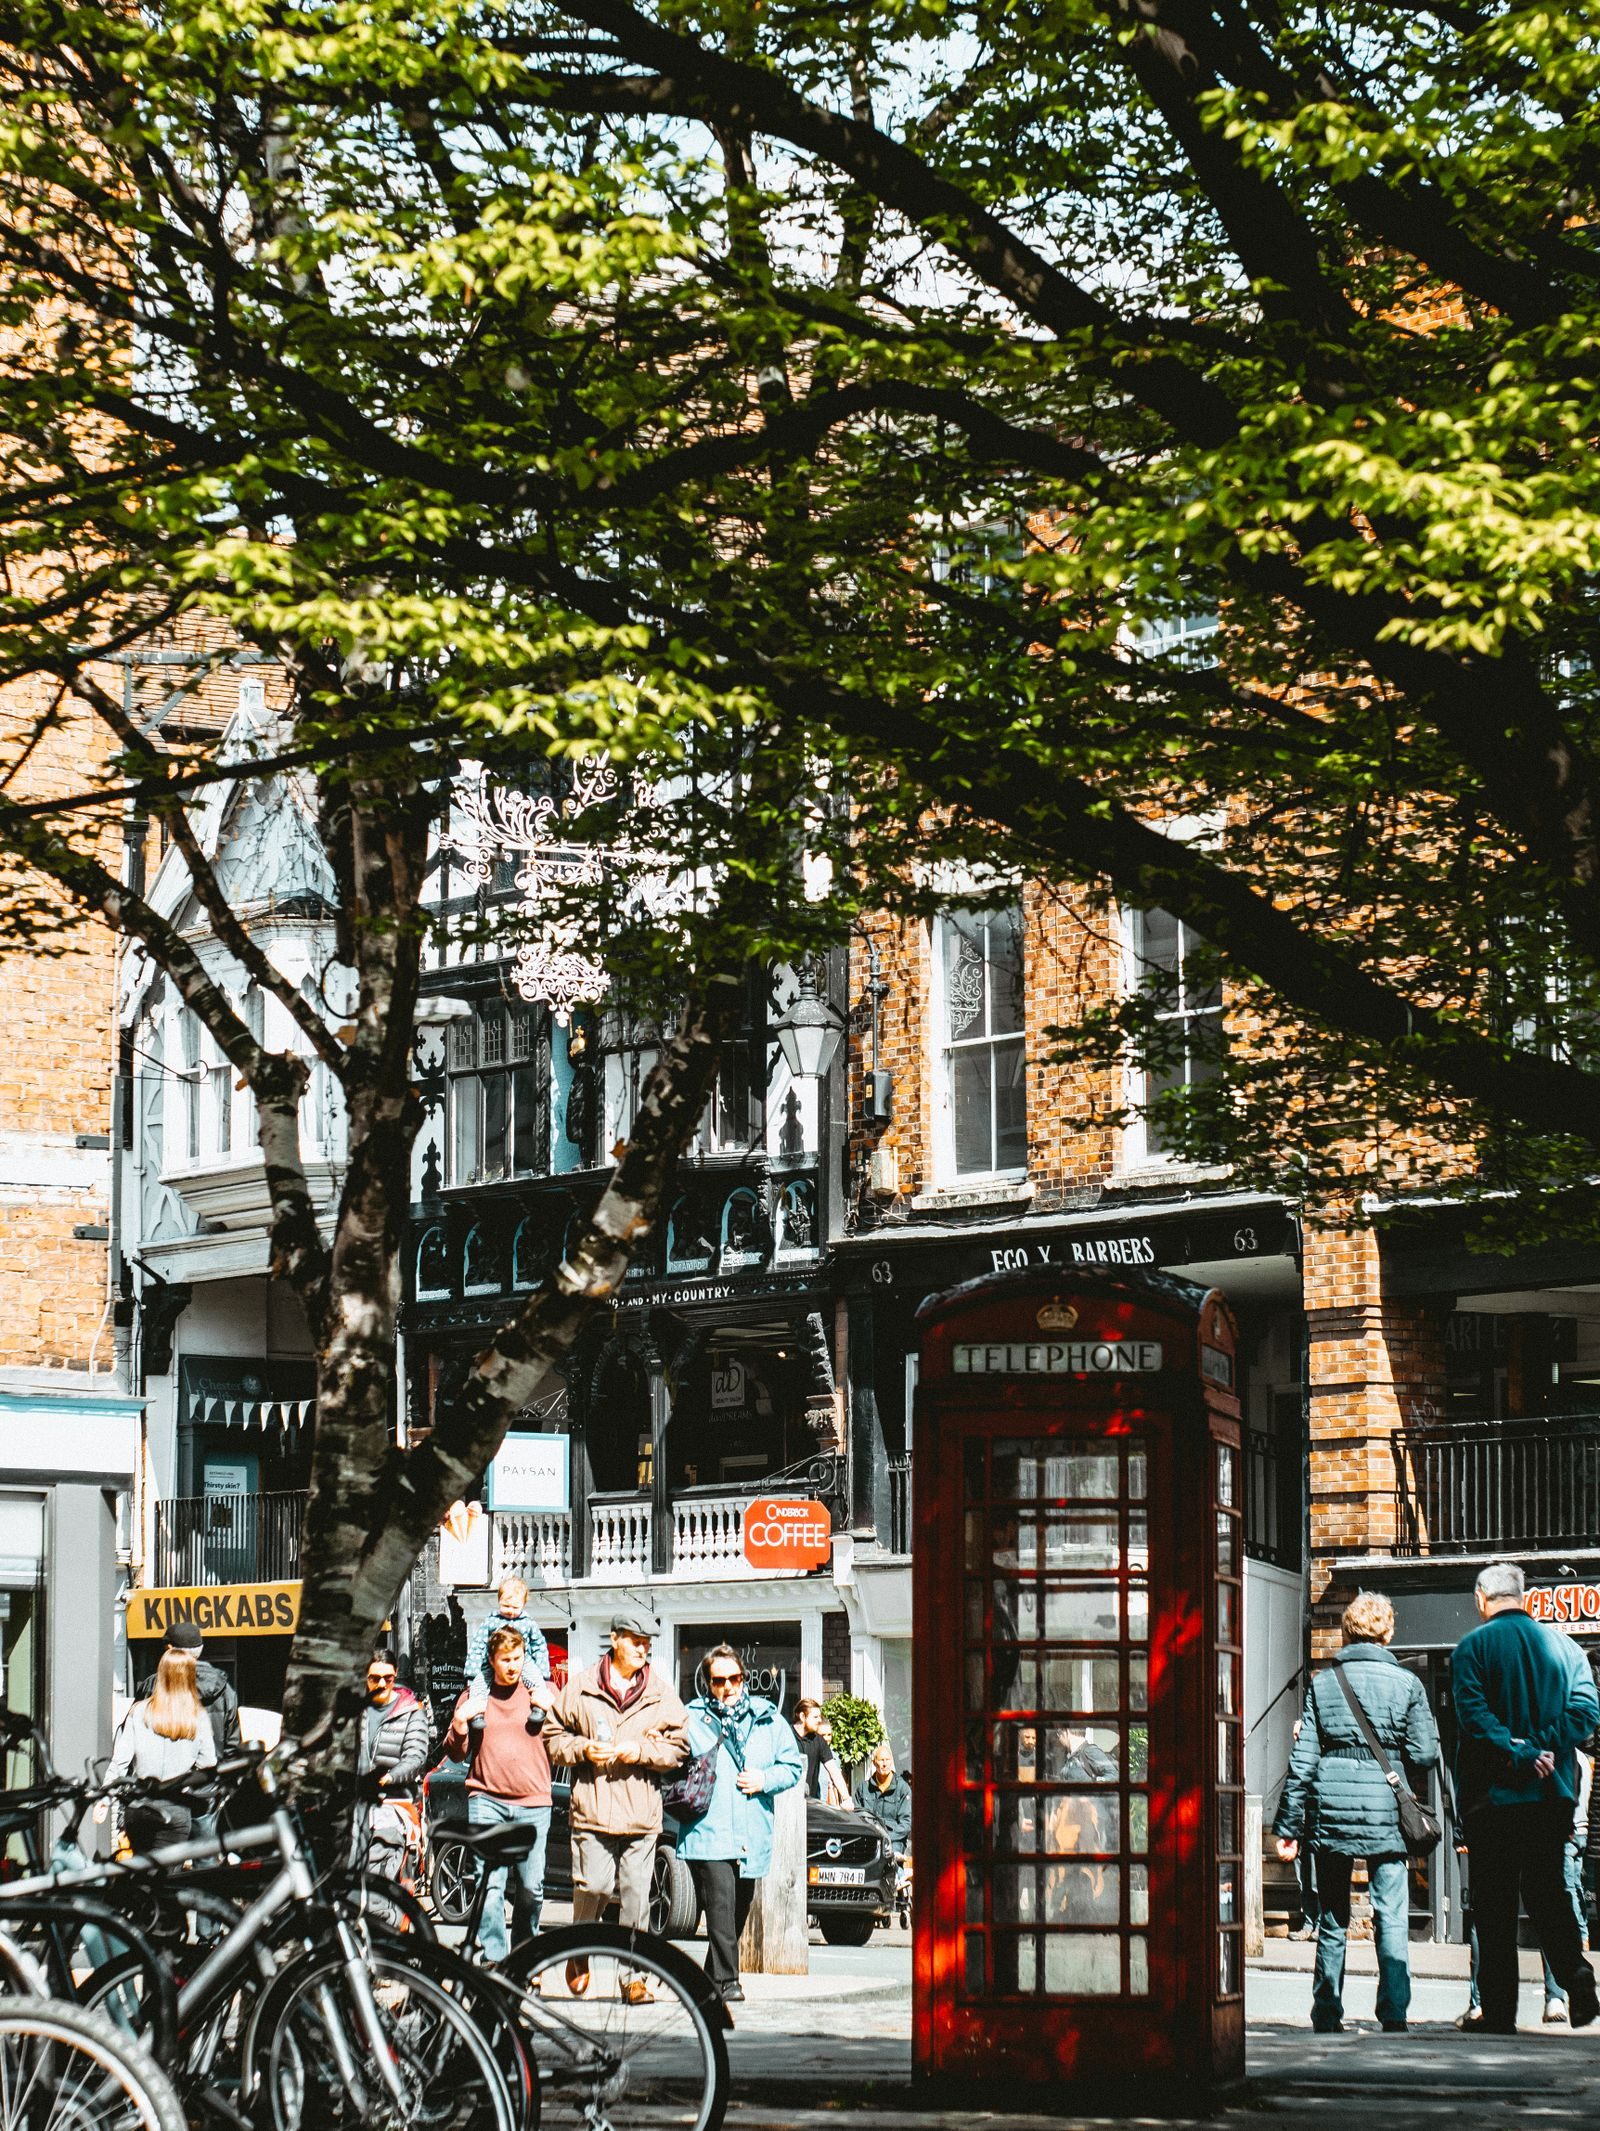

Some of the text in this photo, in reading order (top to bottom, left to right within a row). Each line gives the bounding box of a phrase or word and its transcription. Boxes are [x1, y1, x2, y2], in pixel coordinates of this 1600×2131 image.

[1071, 1236, 1154, 1264] BARBERS
[1234, 1228, 1258, 1252] 63
[872, 1261, 894, 1284] 63
[627, 1296, 644, 1307] AND
[652, 1293, 667, 1305] MY
[674, 1286, 730, 1303] COUNTRY
[961, 1344, 1156, 1373] TELEPHONE
[502, 1465, 556, 1477] PAYSAN
[203, 1481, 241, 1490] Thirsty skin?
[749, 1522, 826, 1547] COFFEE
[144, 1592, 294, 1631] KINGKABS
